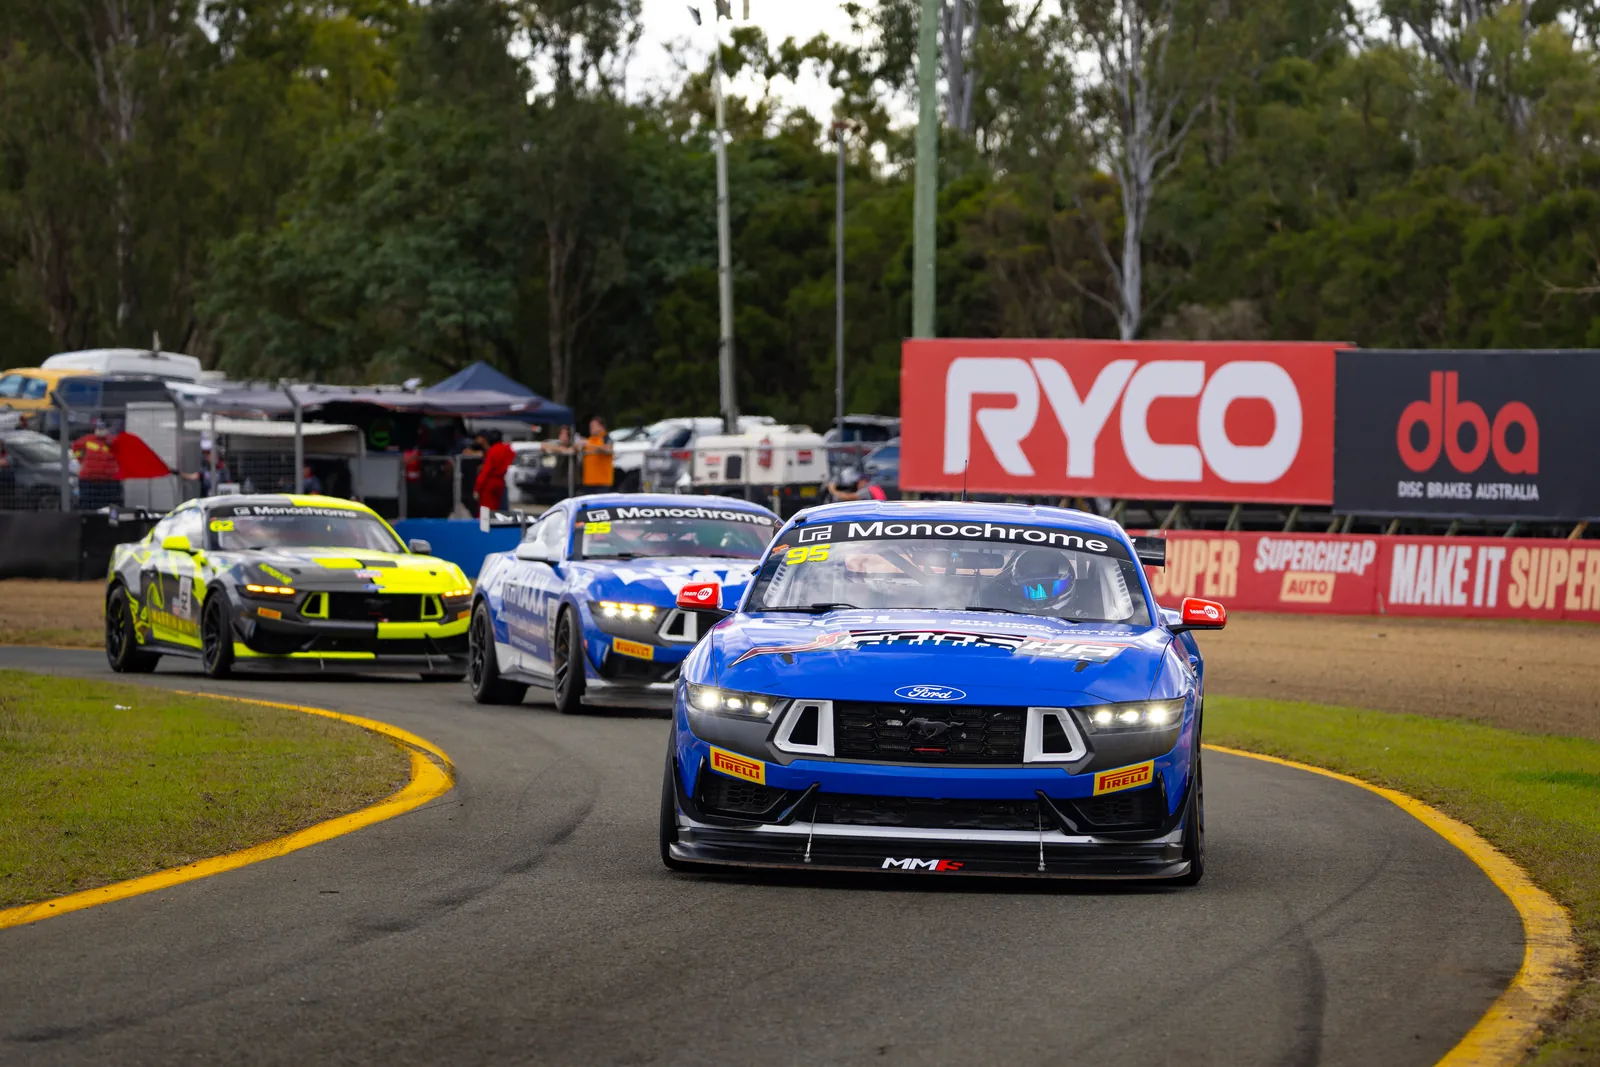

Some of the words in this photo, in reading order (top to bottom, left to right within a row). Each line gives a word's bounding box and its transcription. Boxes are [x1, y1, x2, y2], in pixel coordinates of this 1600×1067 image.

[943, 356, 1304, 484] RYCO
[1396, 370, 1540, 475] dba
[1397, 480, 1425, 498] DISC
[1427, 482, 1473, 500] BRAKES
[1475, 483, 1540, 501] AUSTRALIA
[253, 505, 358, 520] Monochrome
[616, 507, 772, 526] Monochrome
[848, 521, 1109, 552] Monochrome
[786, 544, 831, 565] 95
[1254, 536, 1377, 576] SUPERCHEAP
[1153, 538, 1241, 599] SUPER
[1389, 543, 1472, 607] MAKE
[1473, 545, 1507, 608] IT
[1508, 546, 1600, 611] SUPER
[698, 588, 712, 599] dh
[1287, 579, 1329, 597] AUTO
[1189, 608, 1204, 616] team
[1205, 606, 1218, 618] dh
[907, 686, 952, 700] Ford
[714, 751, 761, 780] PIRELLI
[1098, 765, 1150, 791] PIRELLI
